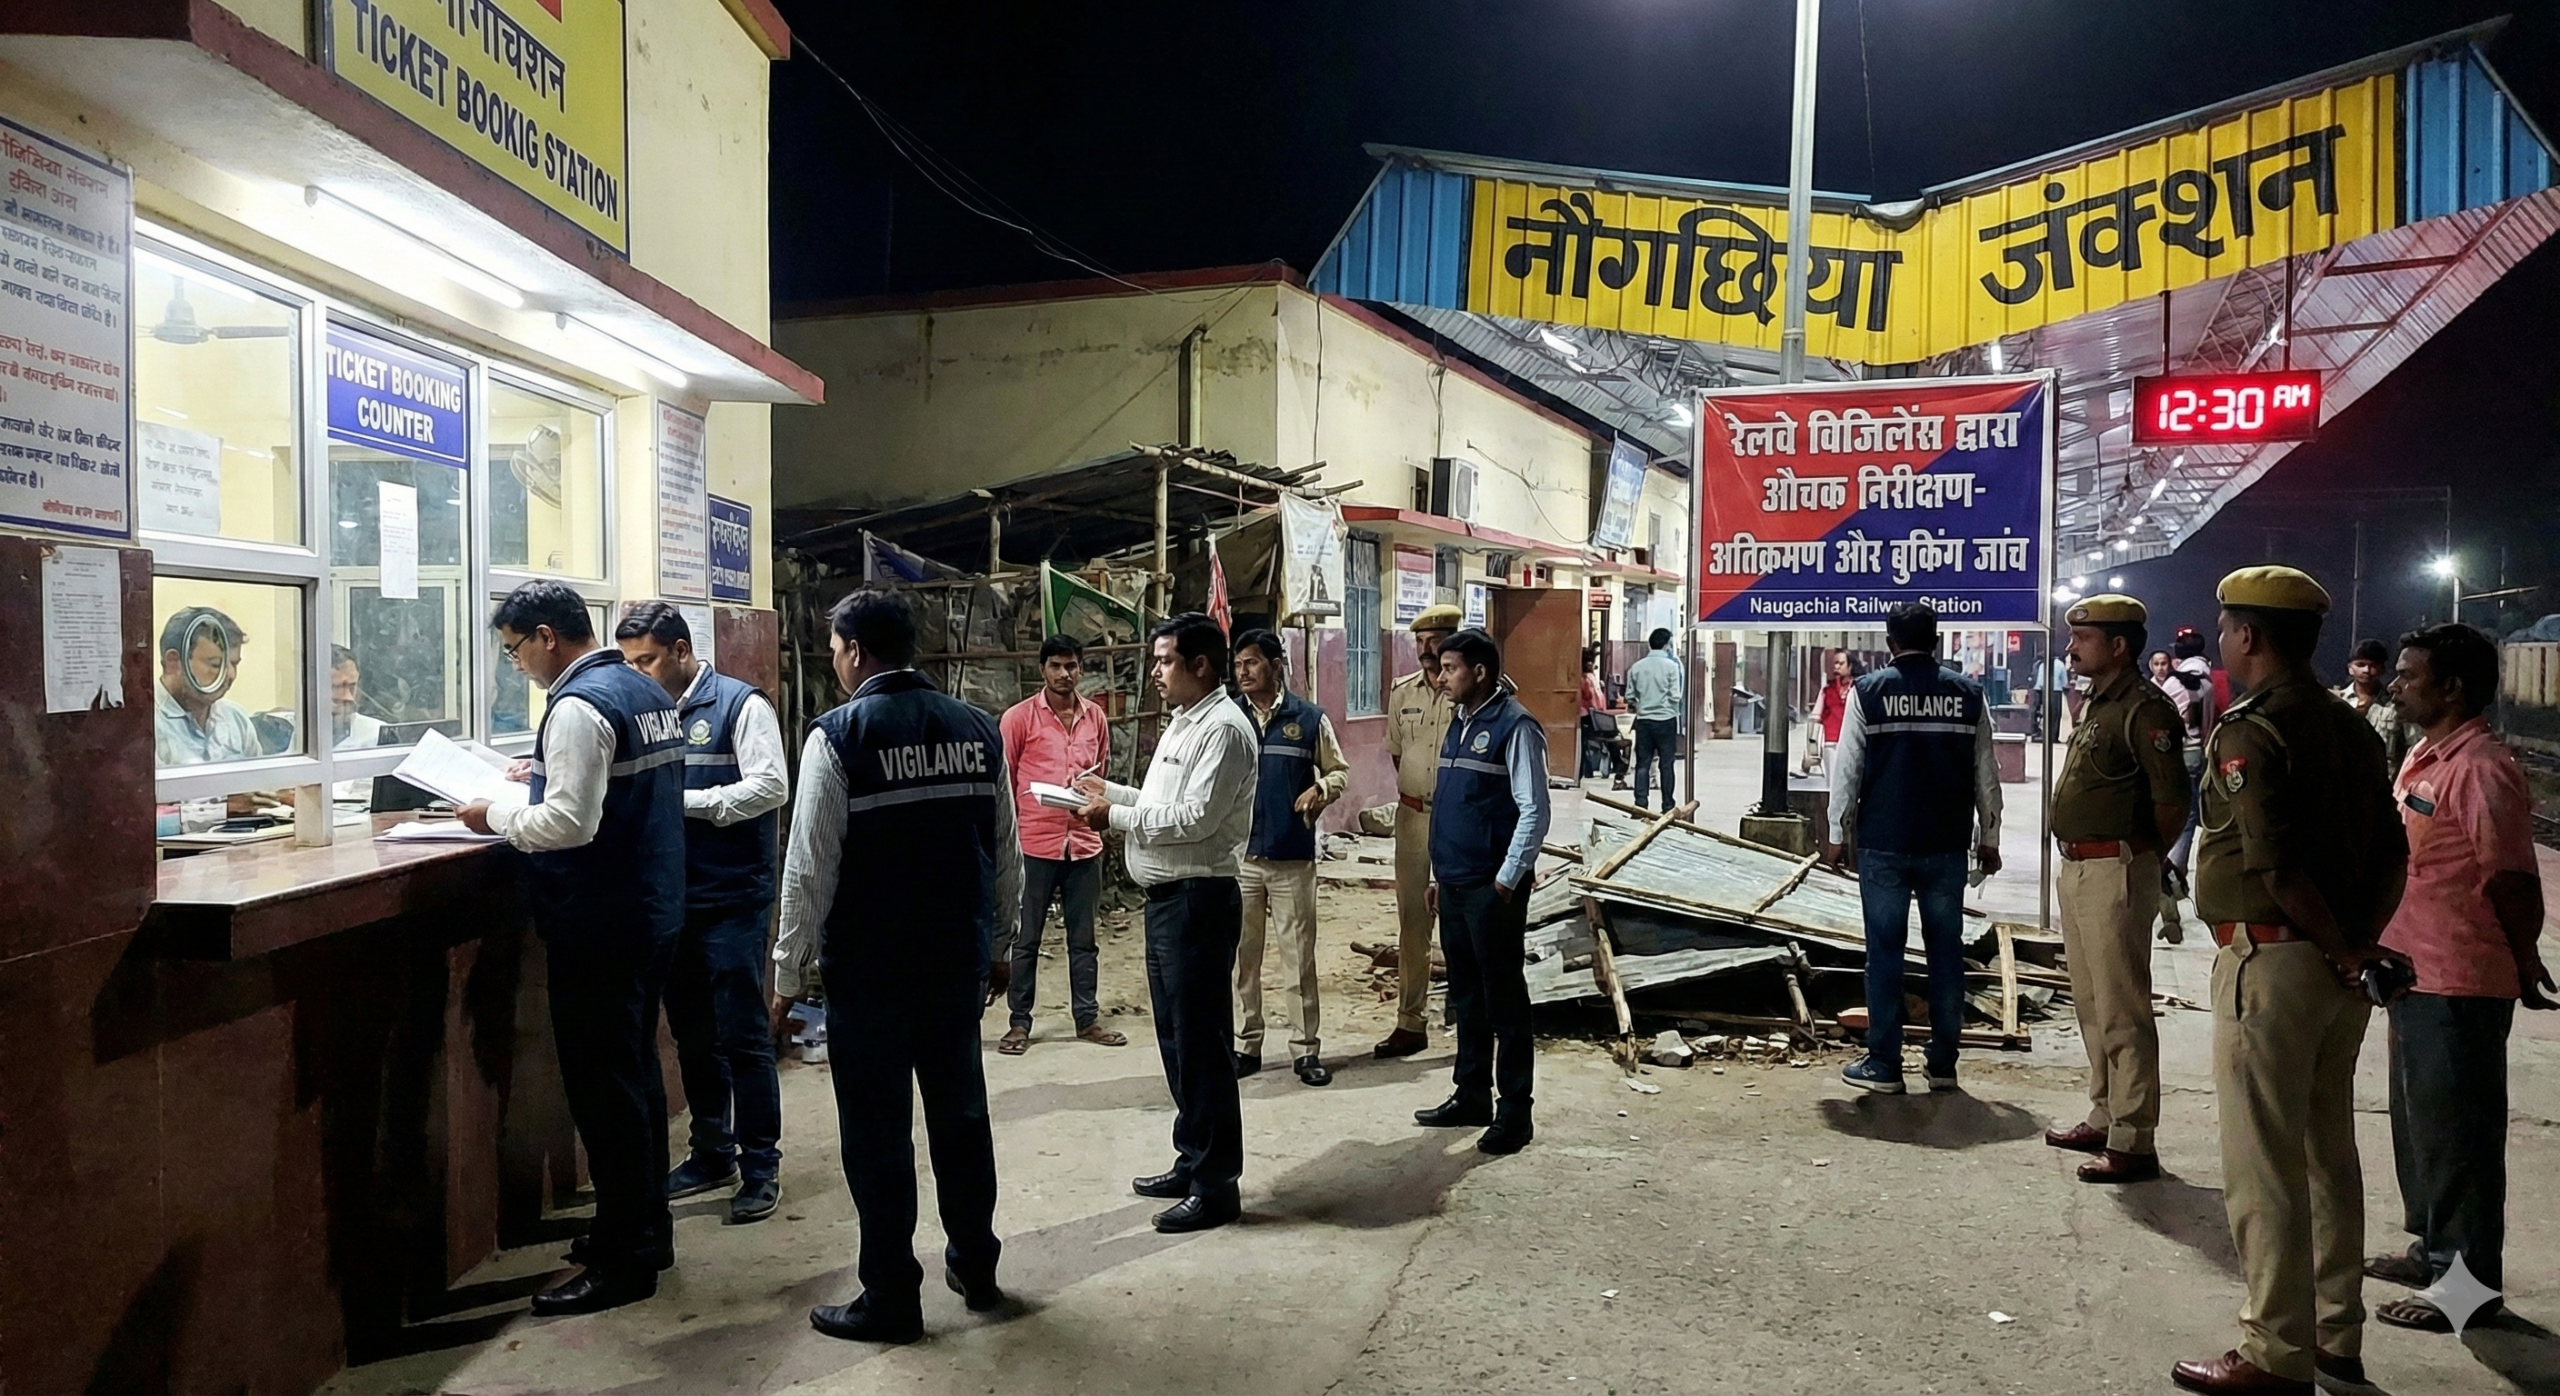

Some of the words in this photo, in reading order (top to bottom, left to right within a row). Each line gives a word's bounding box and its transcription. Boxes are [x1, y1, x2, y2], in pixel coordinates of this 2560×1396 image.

[351, 0, 448, 107] TICKET
[456, 65, 539, 169] BOOKIG
[544, 131, 619, 223] STATION
[1504, 192, 1904, 332] नौगछिया
[326, 344, 388, 391] TICKET
[391, 365, 461, 414] BOOKING
[357, 396, 435, 444] COUNTER
[1724, 411, 1798, 457] रेलवे
[1808, 405, 1945, 454] विजिलेंस
[1954, 411, 2022, 452] द्वारा
[2158, 388, 2265, 432] 12:30
[2273, 384, 2311, 408] AM
[1762, 467, 1849, 512] औचक
[1857, 463, 1987, 510] निरीक्षण-
[1708, 532, 1827, 577] अतिक्रमण
[1834, 529, 1883, 574] और
[1890, 528, 1966, 585] बुकिंग
[1972, 526, 2030, 572] जांच
[1749, 597, 1840, 618] Naugachia
[1845, 597, 1903, 614] Railw
[1882, 695, 1963, 718] VIGILANCE
[878, 741, 987, 781] VIGILANCE
